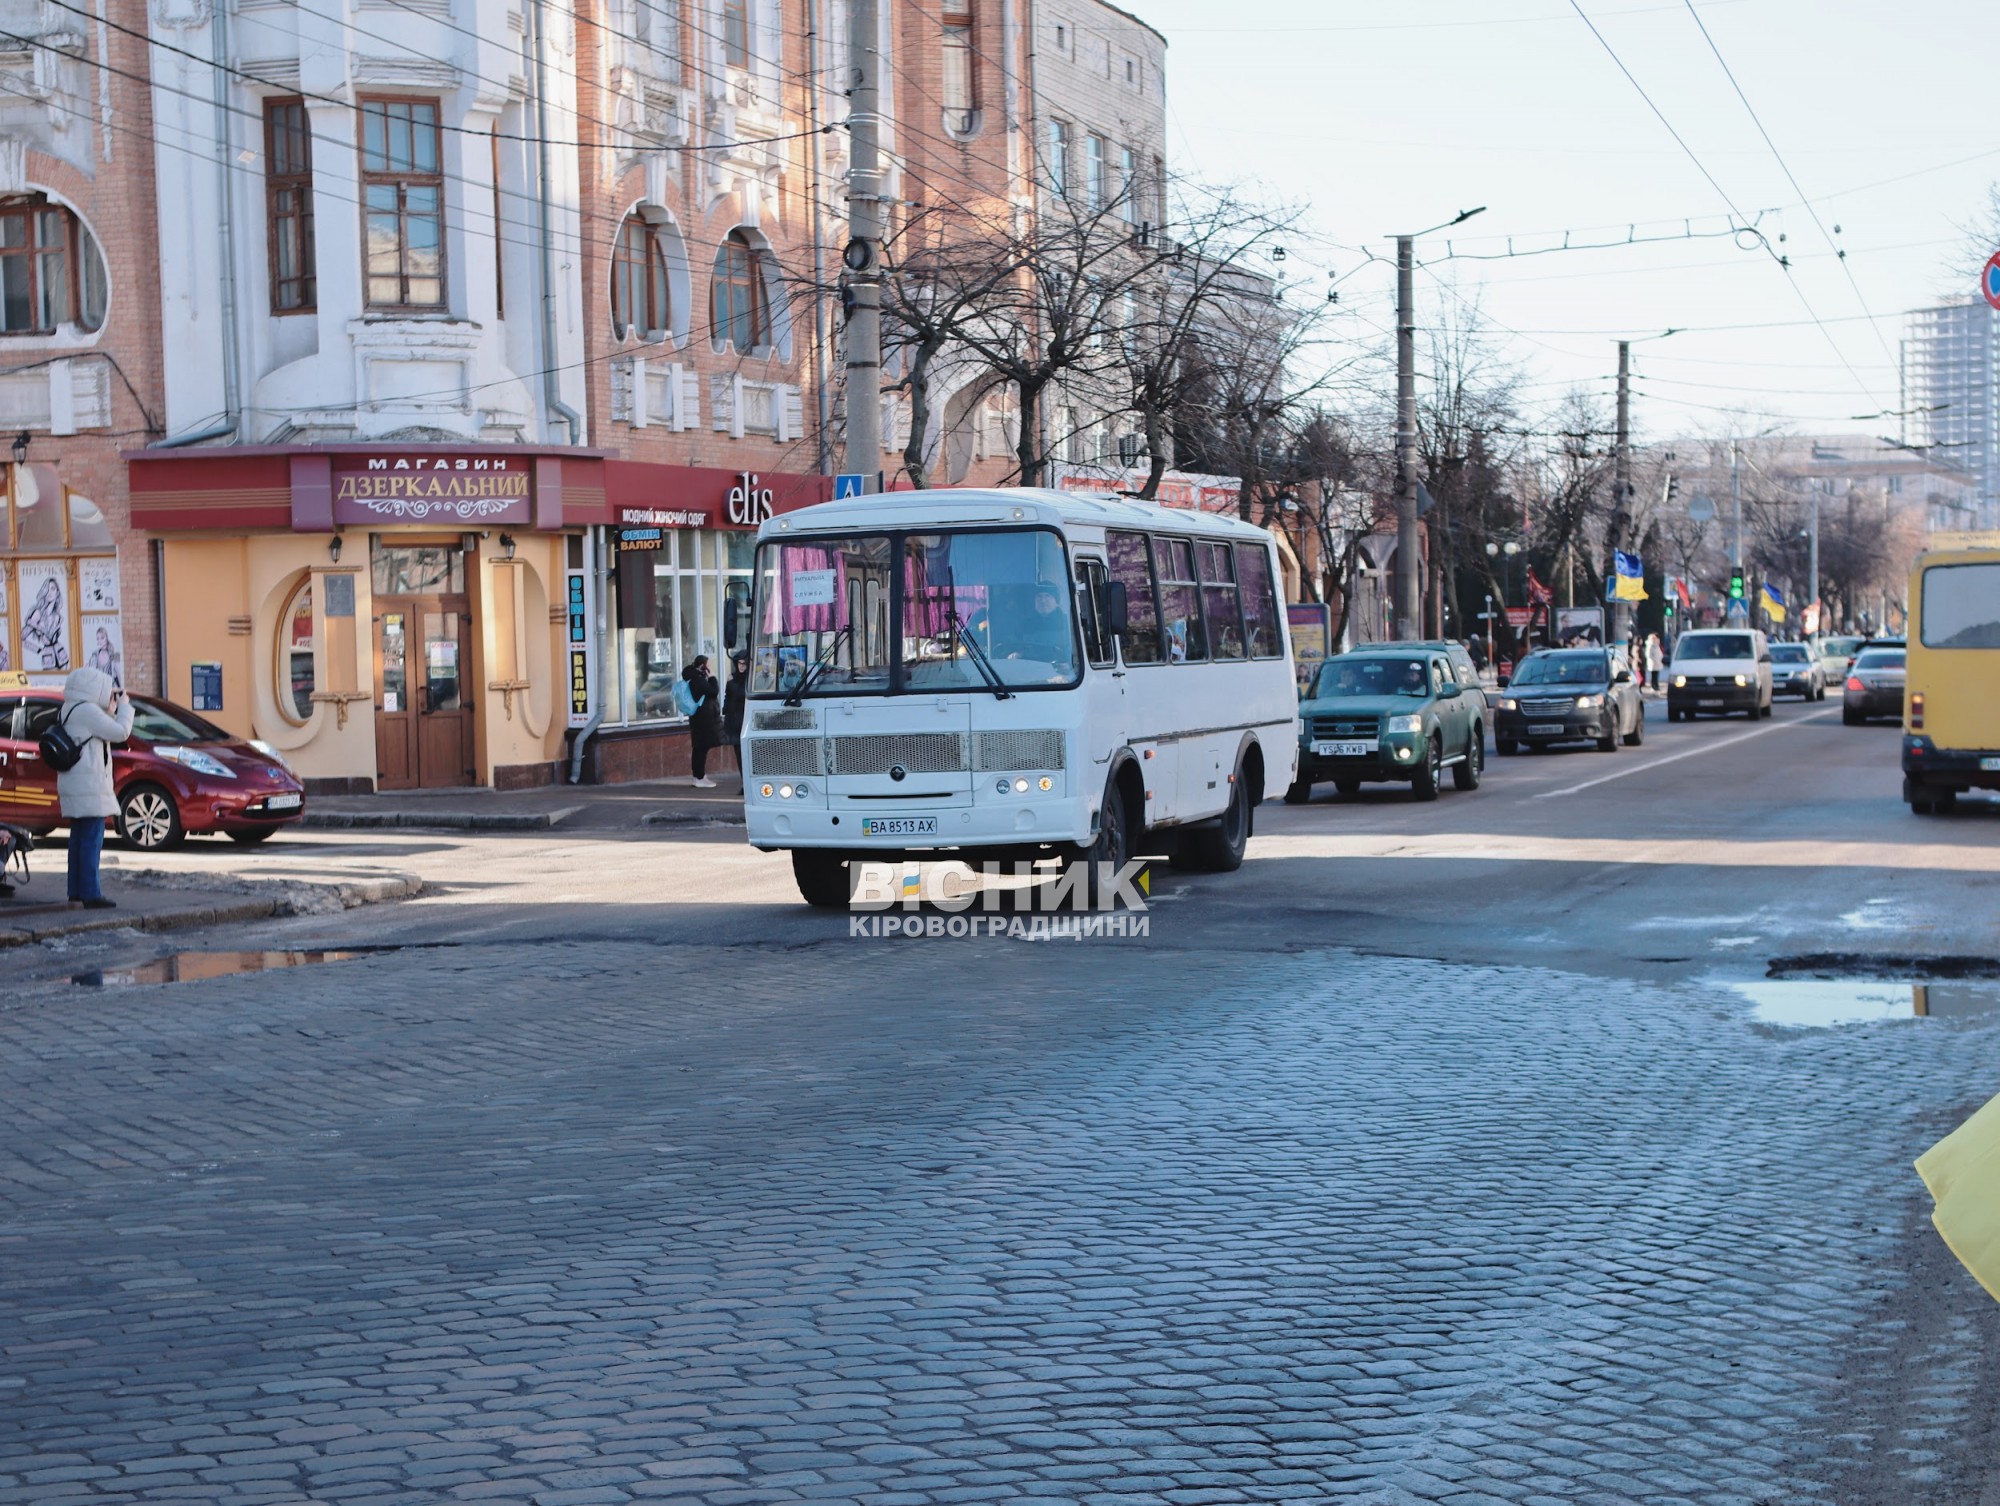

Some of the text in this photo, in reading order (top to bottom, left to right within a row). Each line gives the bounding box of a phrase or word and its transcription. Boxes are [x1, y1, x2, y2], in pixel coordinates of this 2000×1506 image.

[368, 458, 506, 470] МАГАЗИН
[338, 472, 529, 500] ДЗЕРКАЛЬНИЙ
[729, 471, 774, 525] elis
[622, 508, 706, 526] МОДНИЙ ЖІНОЧИЙ ОДЯГ
[622, 529, 660, 540] ОБМІН
[621, 539, 662, 550] ВАЛЮТ
[570, 576, 584, 640] ОБМІН
[573, 654, 587, 713] ВАЛЮТ
[870, 821, 887, 833] BA
[889, 820, 915, 832] 8513
[918, 820, 934, 832] AX
